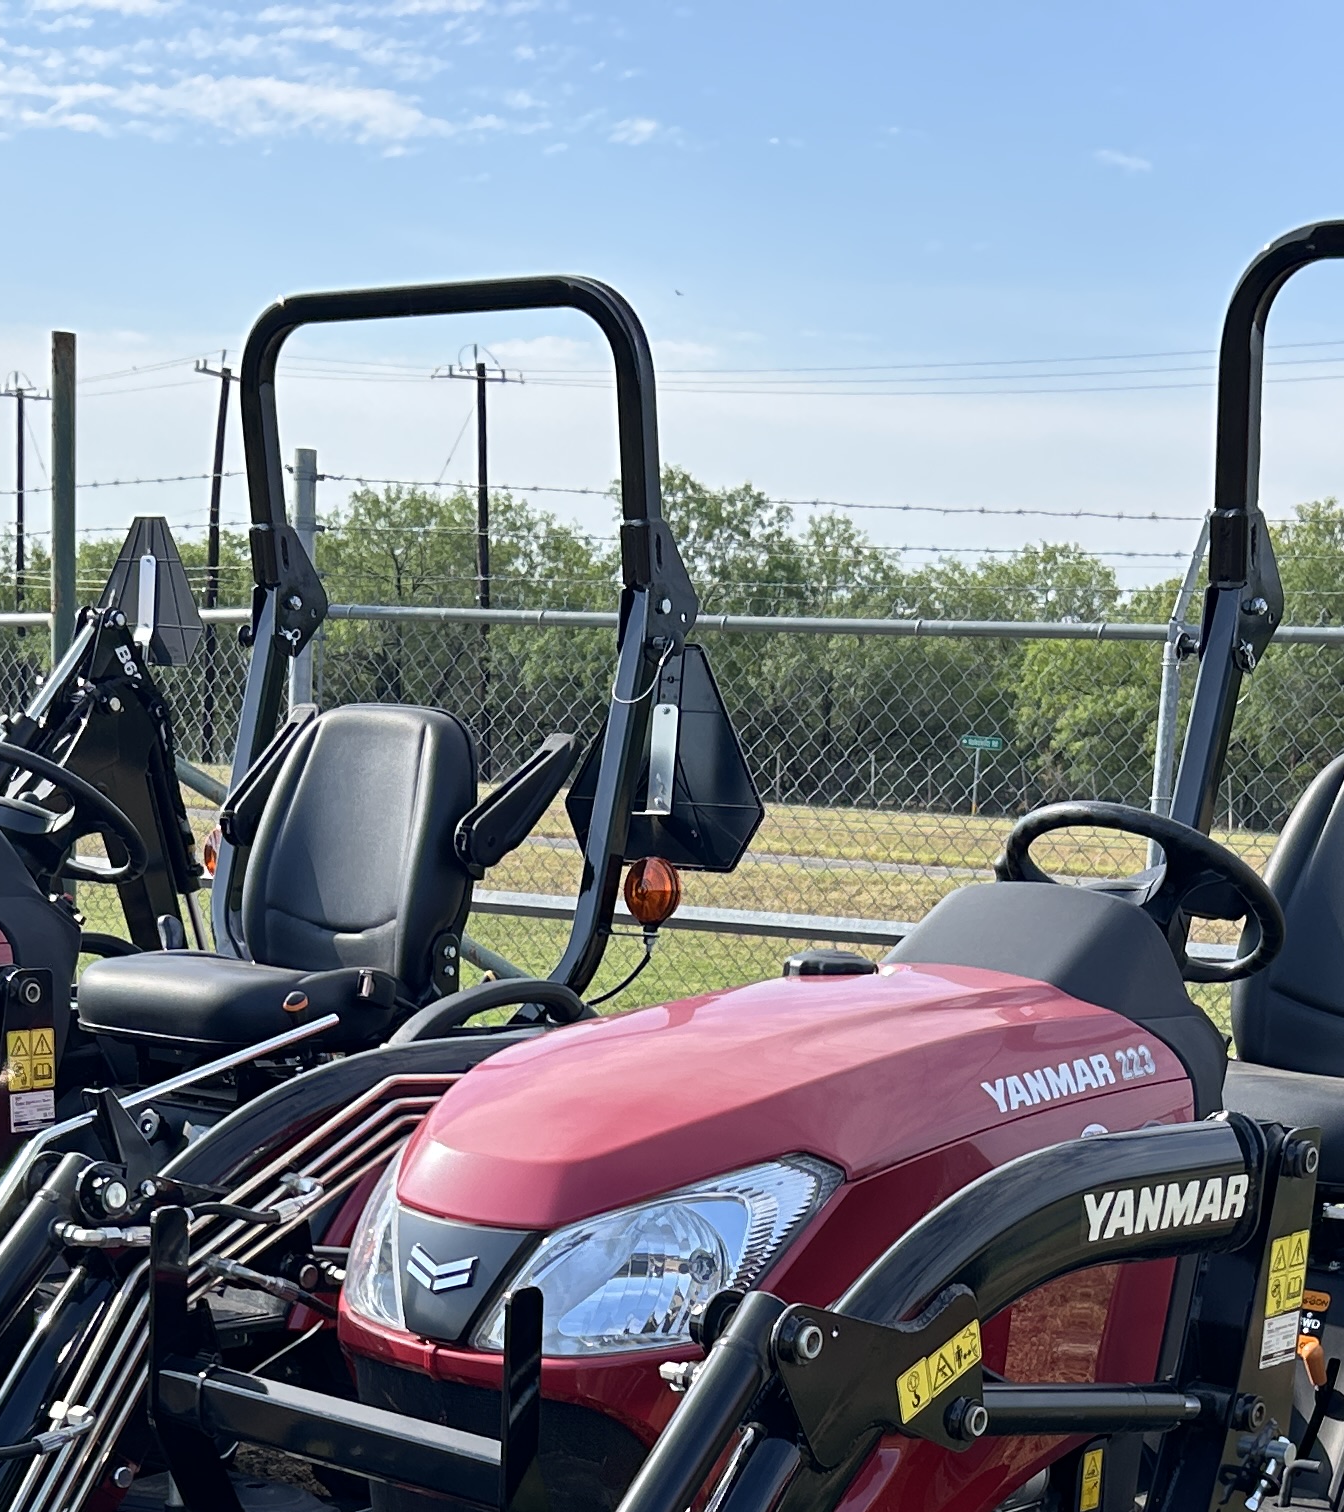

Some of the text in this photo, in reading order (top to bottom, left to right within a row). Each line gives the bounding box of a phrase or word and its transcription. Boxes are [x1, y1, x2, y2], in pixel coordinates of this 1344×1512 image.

[981, 1044, 1156, 1113] YANMAR 223
[1083, 1174, 1249, 1242] YANMAR
[1301, 1317, 1320, 1329] WD
